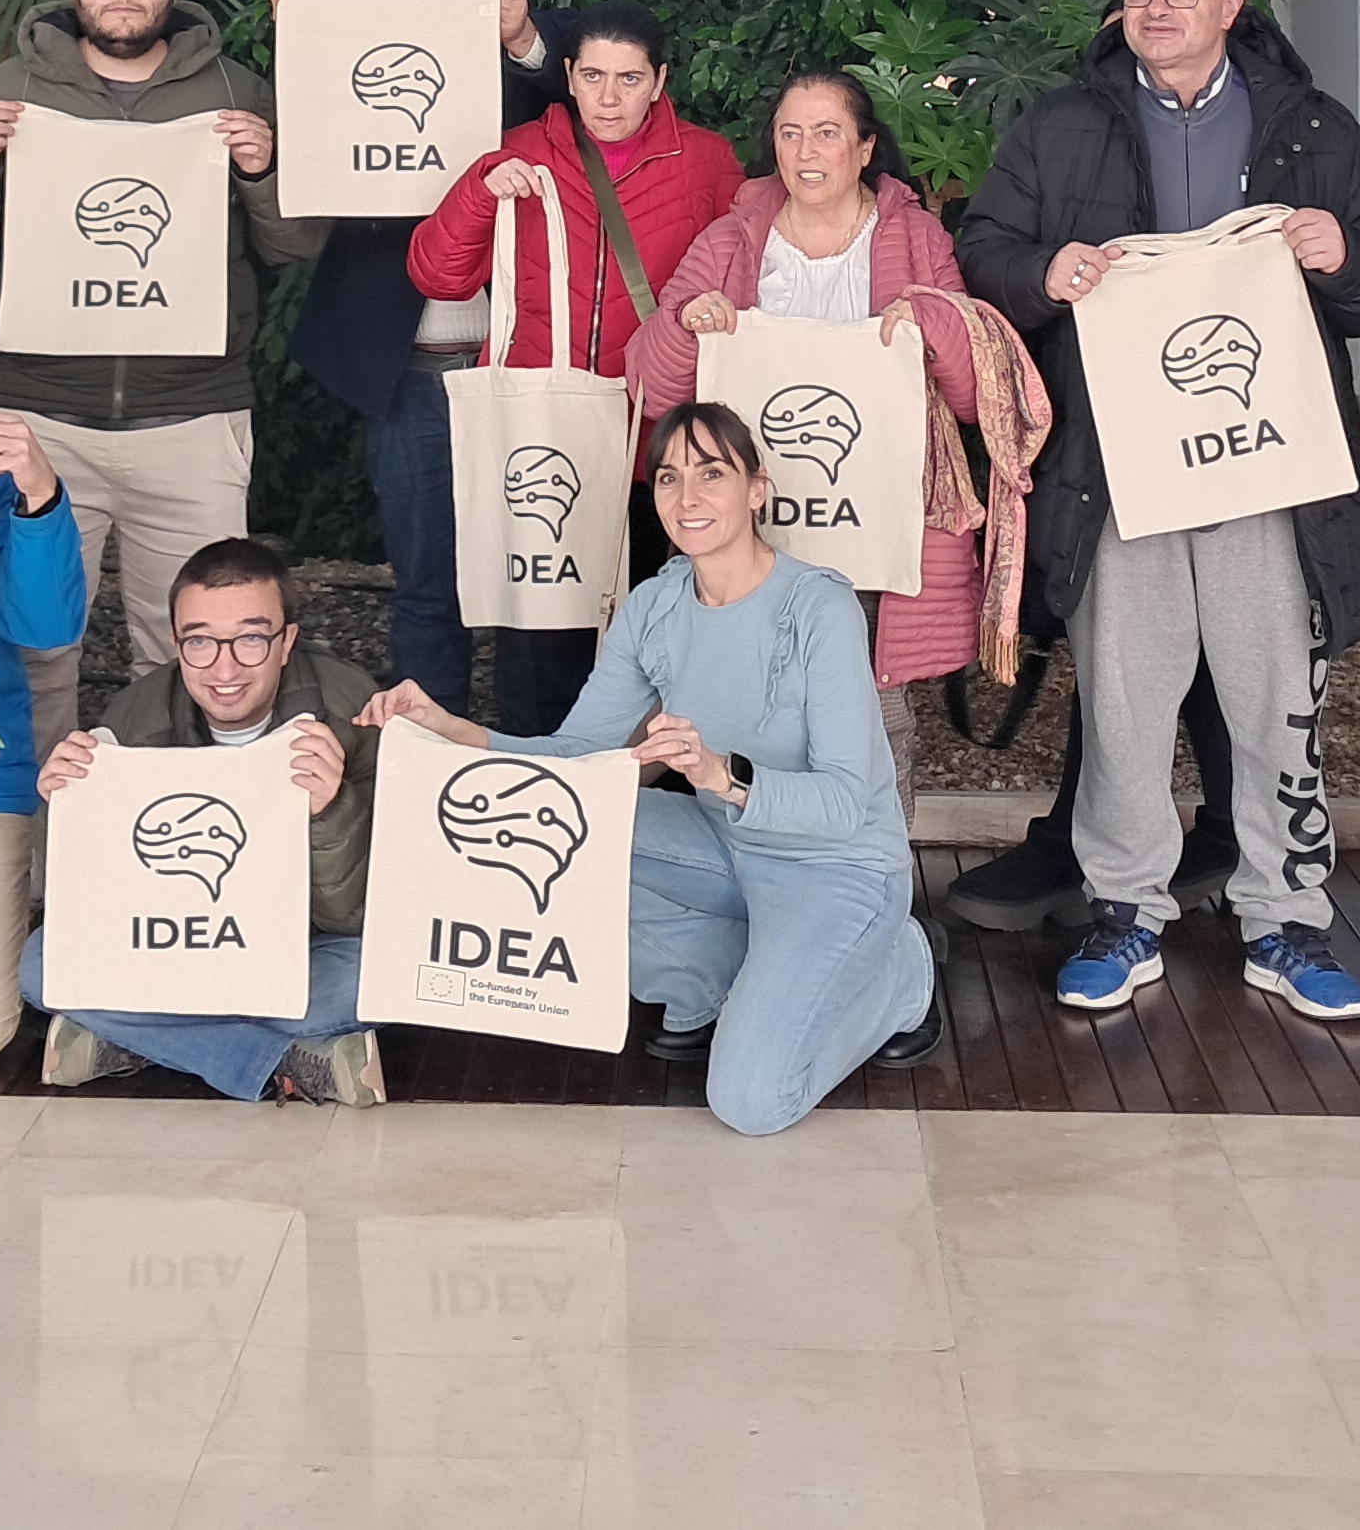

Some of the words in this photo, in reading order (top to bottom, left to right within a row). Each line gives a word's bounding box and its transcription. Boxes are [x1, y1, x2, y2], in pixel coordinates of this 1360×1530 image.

[352, 144, 447, 172] IDEA
[72, 279, 169, 308] IDEA
[1180, 418, 1286, 469] IDEA
[132, 915, 247, 950] IDEA
[429, 917, 579, 984] IDEA
[469, 978, 523, 995] Co-funded
[524, 987, 538, 1000] by
[469, 992, 486, 1003] the
[487, 995, 536, 1012] European
[538, 1003, 570, 1017] Union
